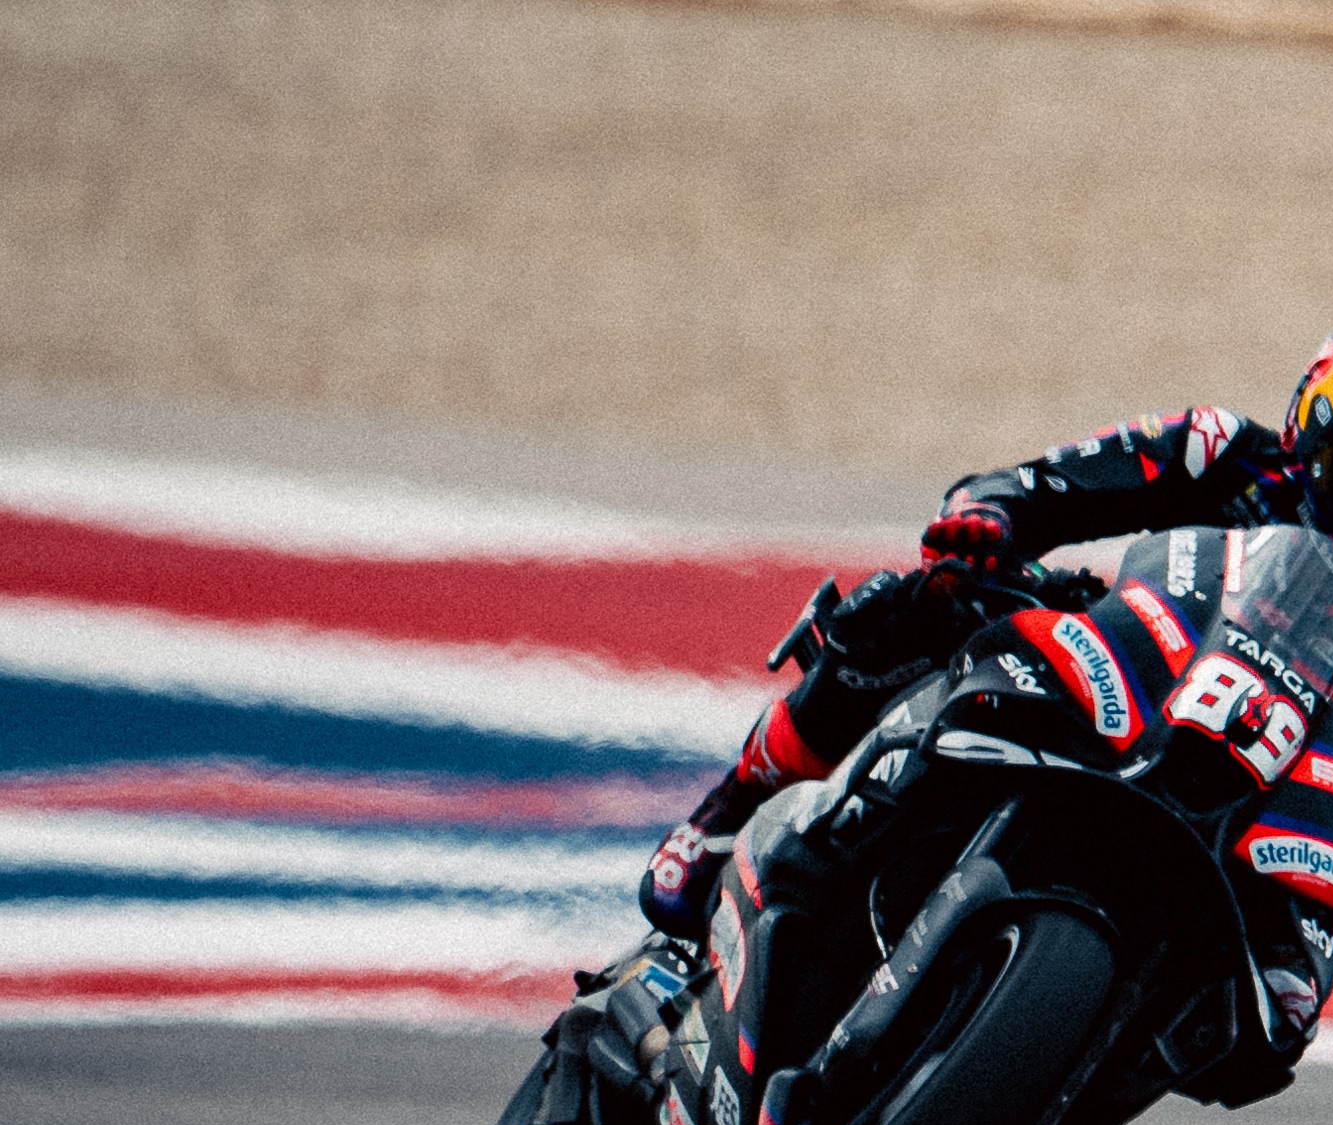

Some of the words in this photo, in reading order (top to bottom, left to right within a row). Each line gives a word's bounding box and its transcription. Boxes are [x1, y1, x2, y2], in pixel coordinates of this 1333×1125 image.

[997, 653, 1047, 695] sky
[1061, 622, 1127, 729] sterilgarda
[1225, 628, 1316, 715] TARGA
[1163, 652, 1308, 789] 89
